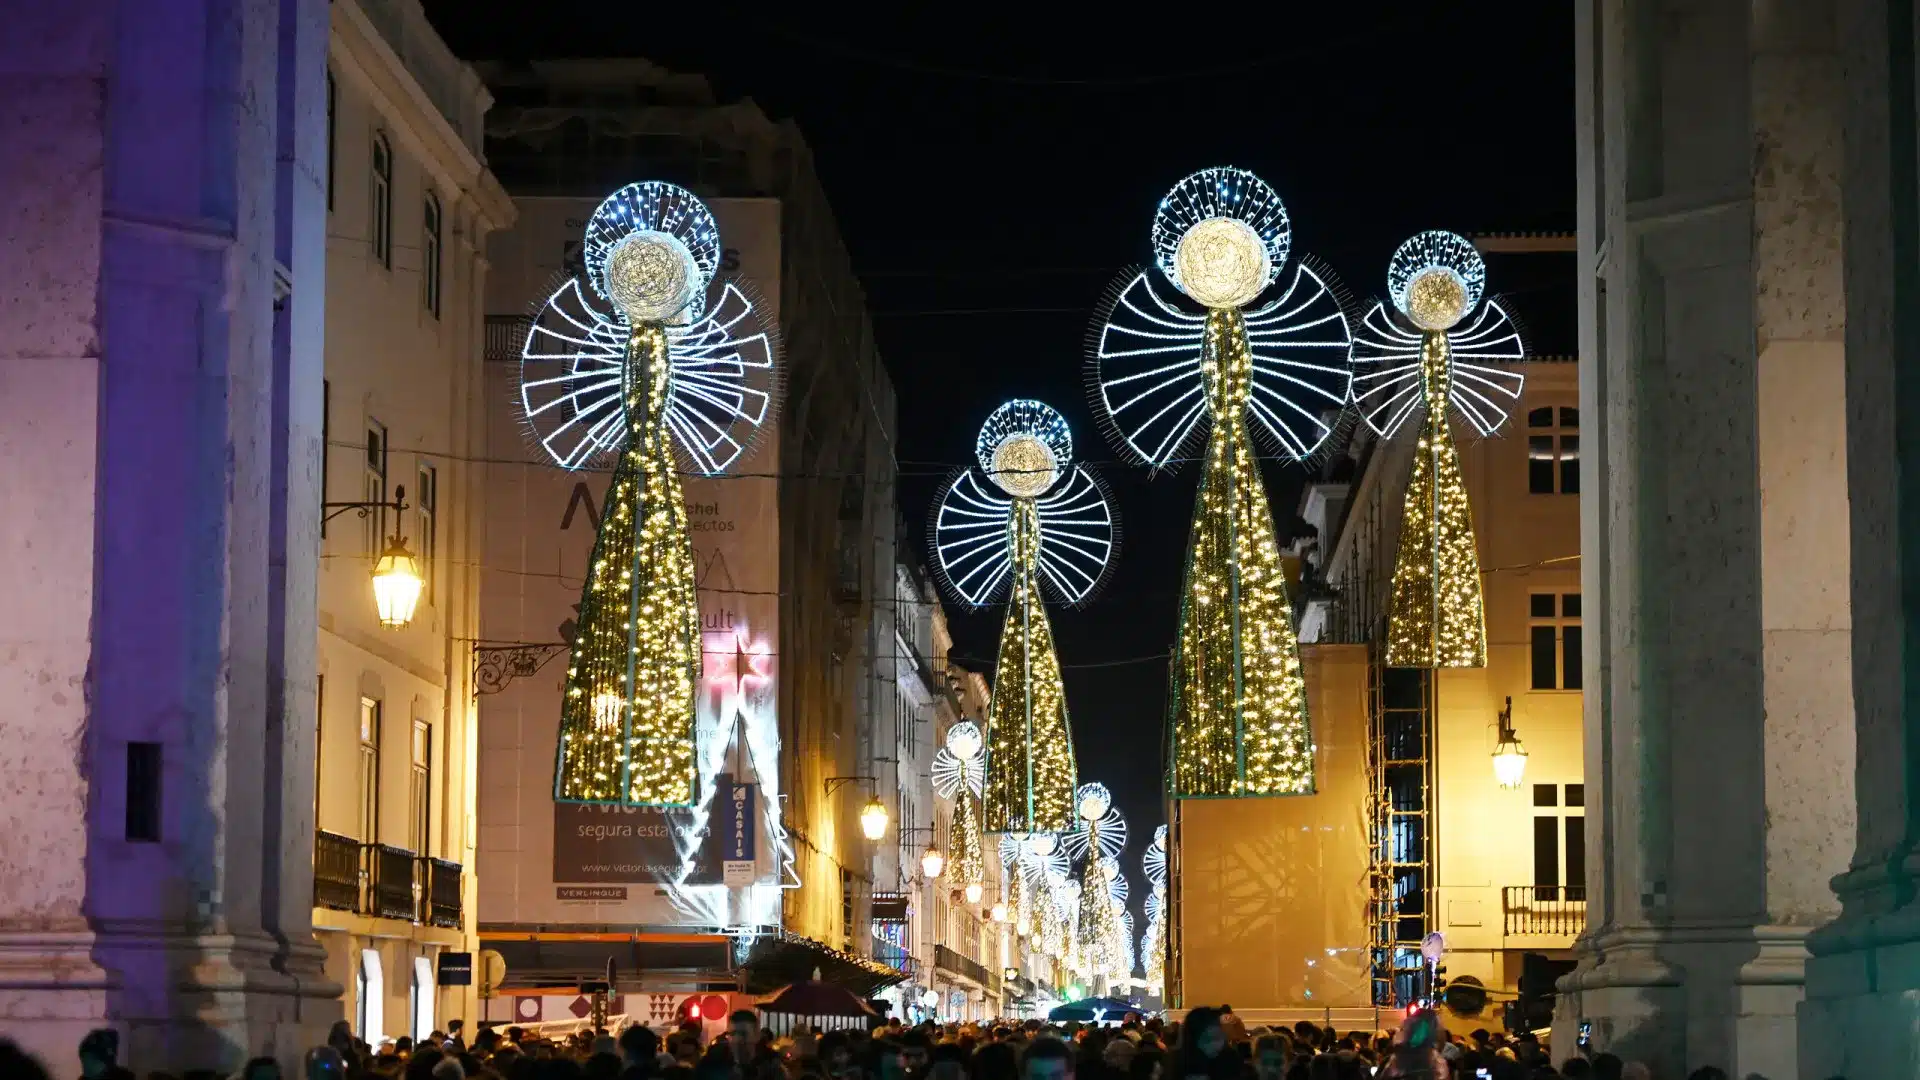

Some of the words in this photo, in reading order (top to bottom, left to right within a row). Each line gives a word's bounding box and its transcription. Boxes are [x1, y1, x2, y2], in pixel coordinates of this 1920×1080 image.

[686, 502, 719, 515] chel
[578, 824, 632, 842] segura
[637, 823, 668, 837] esta
[735, 800, 744, 858] CASAIS
